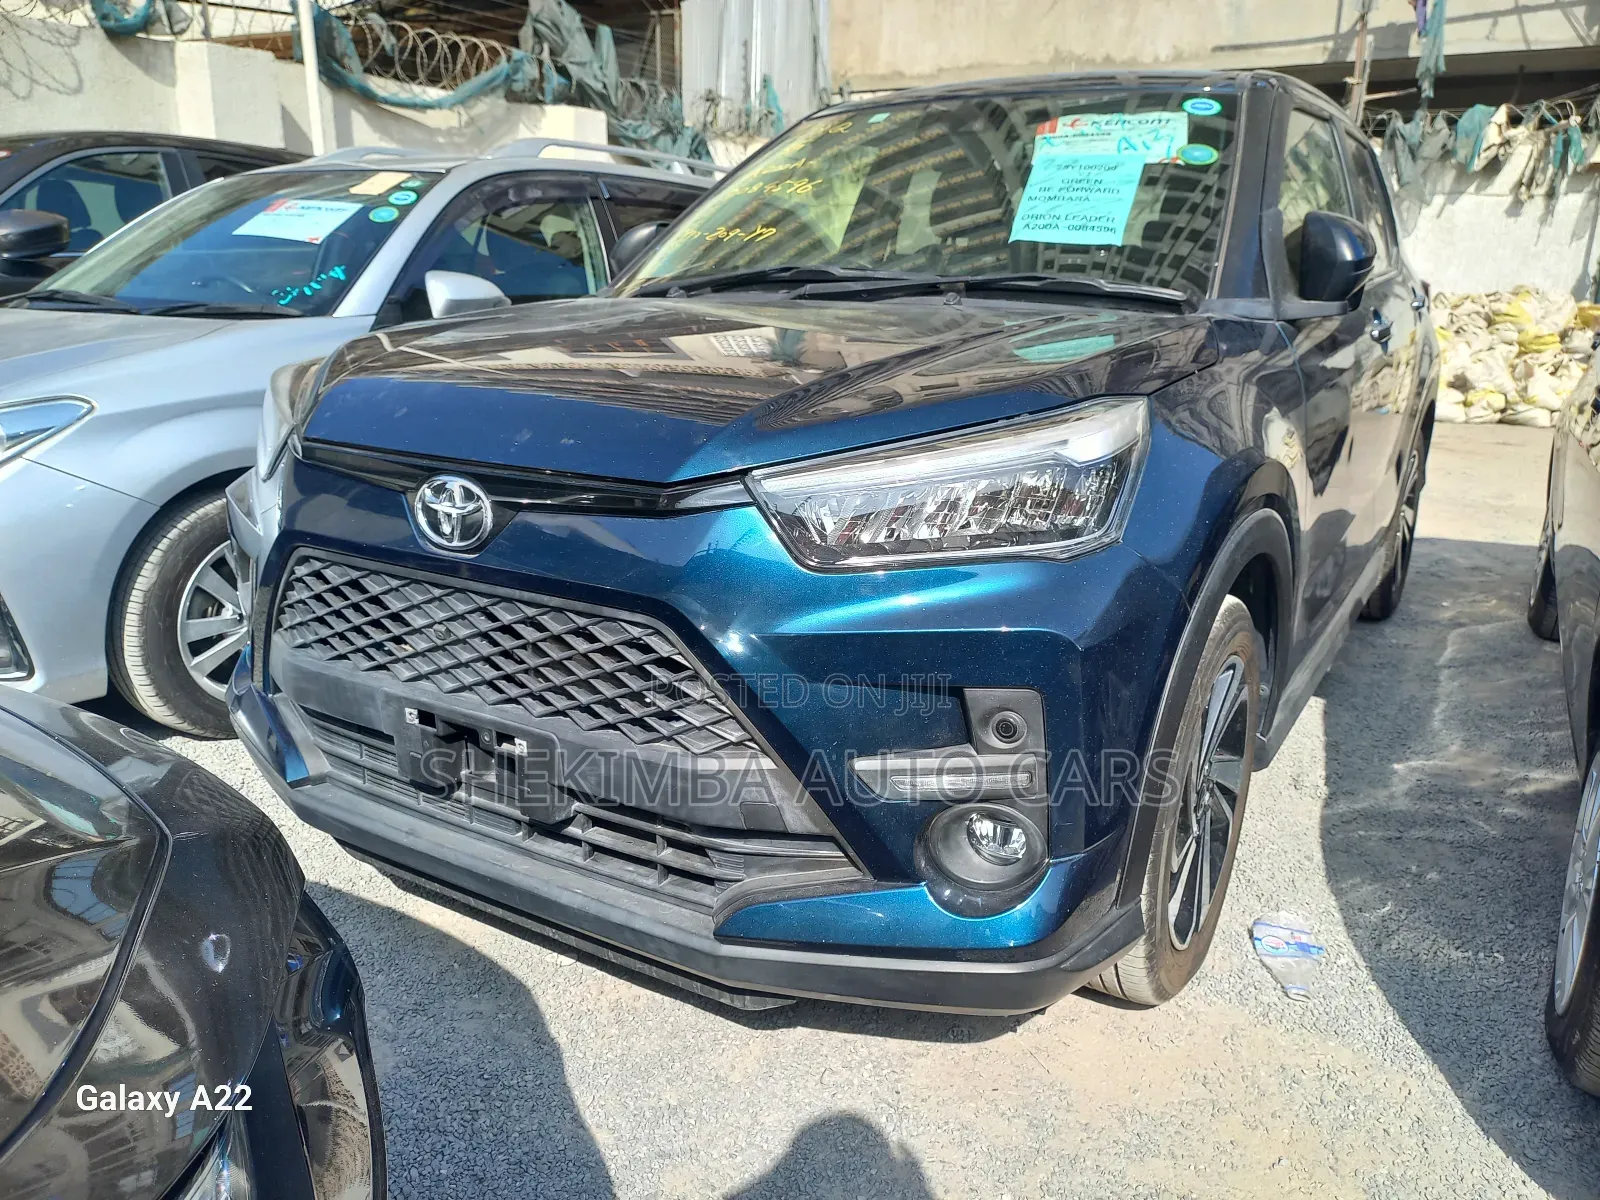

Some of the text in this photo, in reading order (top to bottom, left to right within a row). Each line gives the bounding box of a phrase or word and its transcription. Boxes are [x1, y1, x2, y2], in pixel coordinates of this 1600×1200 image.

[1061, 178, 1104, 186] GREEN
[1057, 187, 1121, 196] FORWARD
[1021, 213, 1117, 224] ORION LEADER
